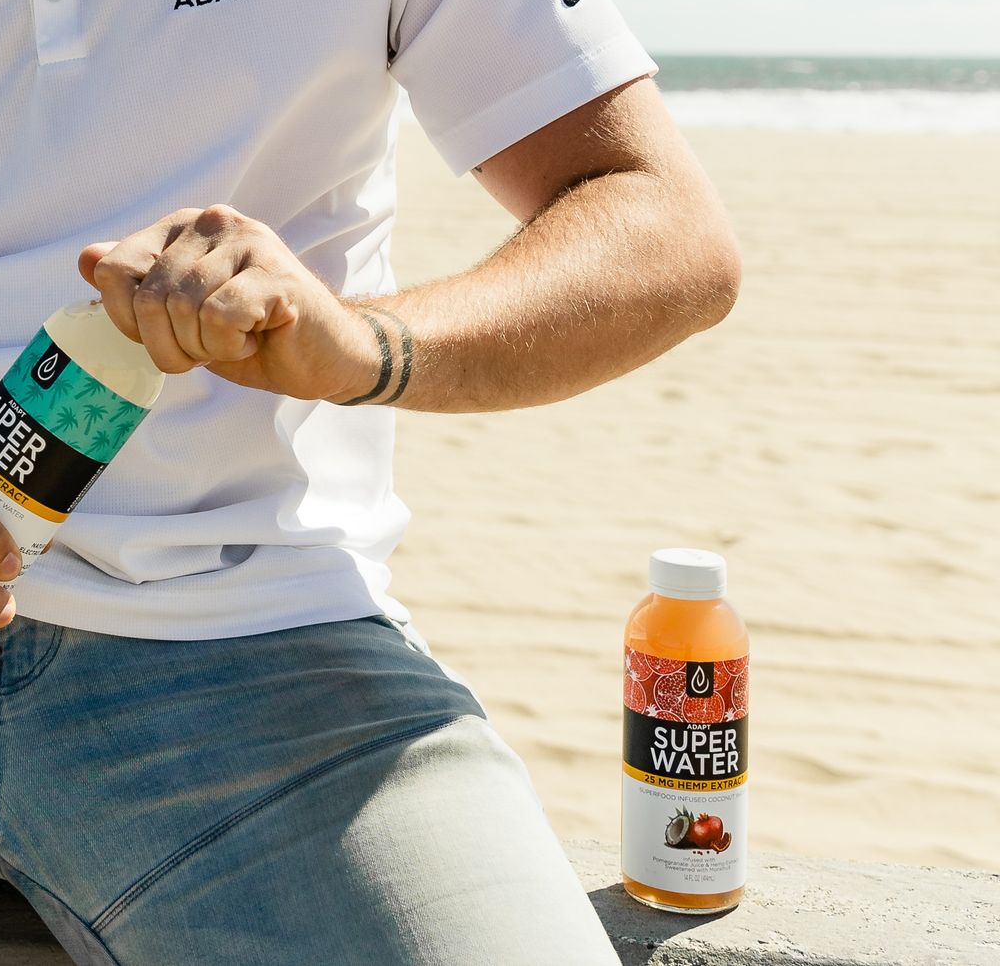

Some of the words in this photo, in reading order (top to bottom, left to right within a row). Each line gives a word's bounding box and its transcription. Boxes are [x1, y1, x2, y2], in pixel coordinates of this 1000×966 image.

[8, 399, 27, 418] ADAPT
[3, 502, 25, 521] WATER
[653, 726, 737, 753] SUPER
[650, 747, 739, 775] WATER
[644, 774, 656, 784] 25
[658, 778, 674, 788] MG
[678, 781, 708, 790] HEMP
[711, 776, 744, 790] EXTRACT
[678, 795, 707, 803] INFUSED
[708, 794, 736, 803] COCONUT
